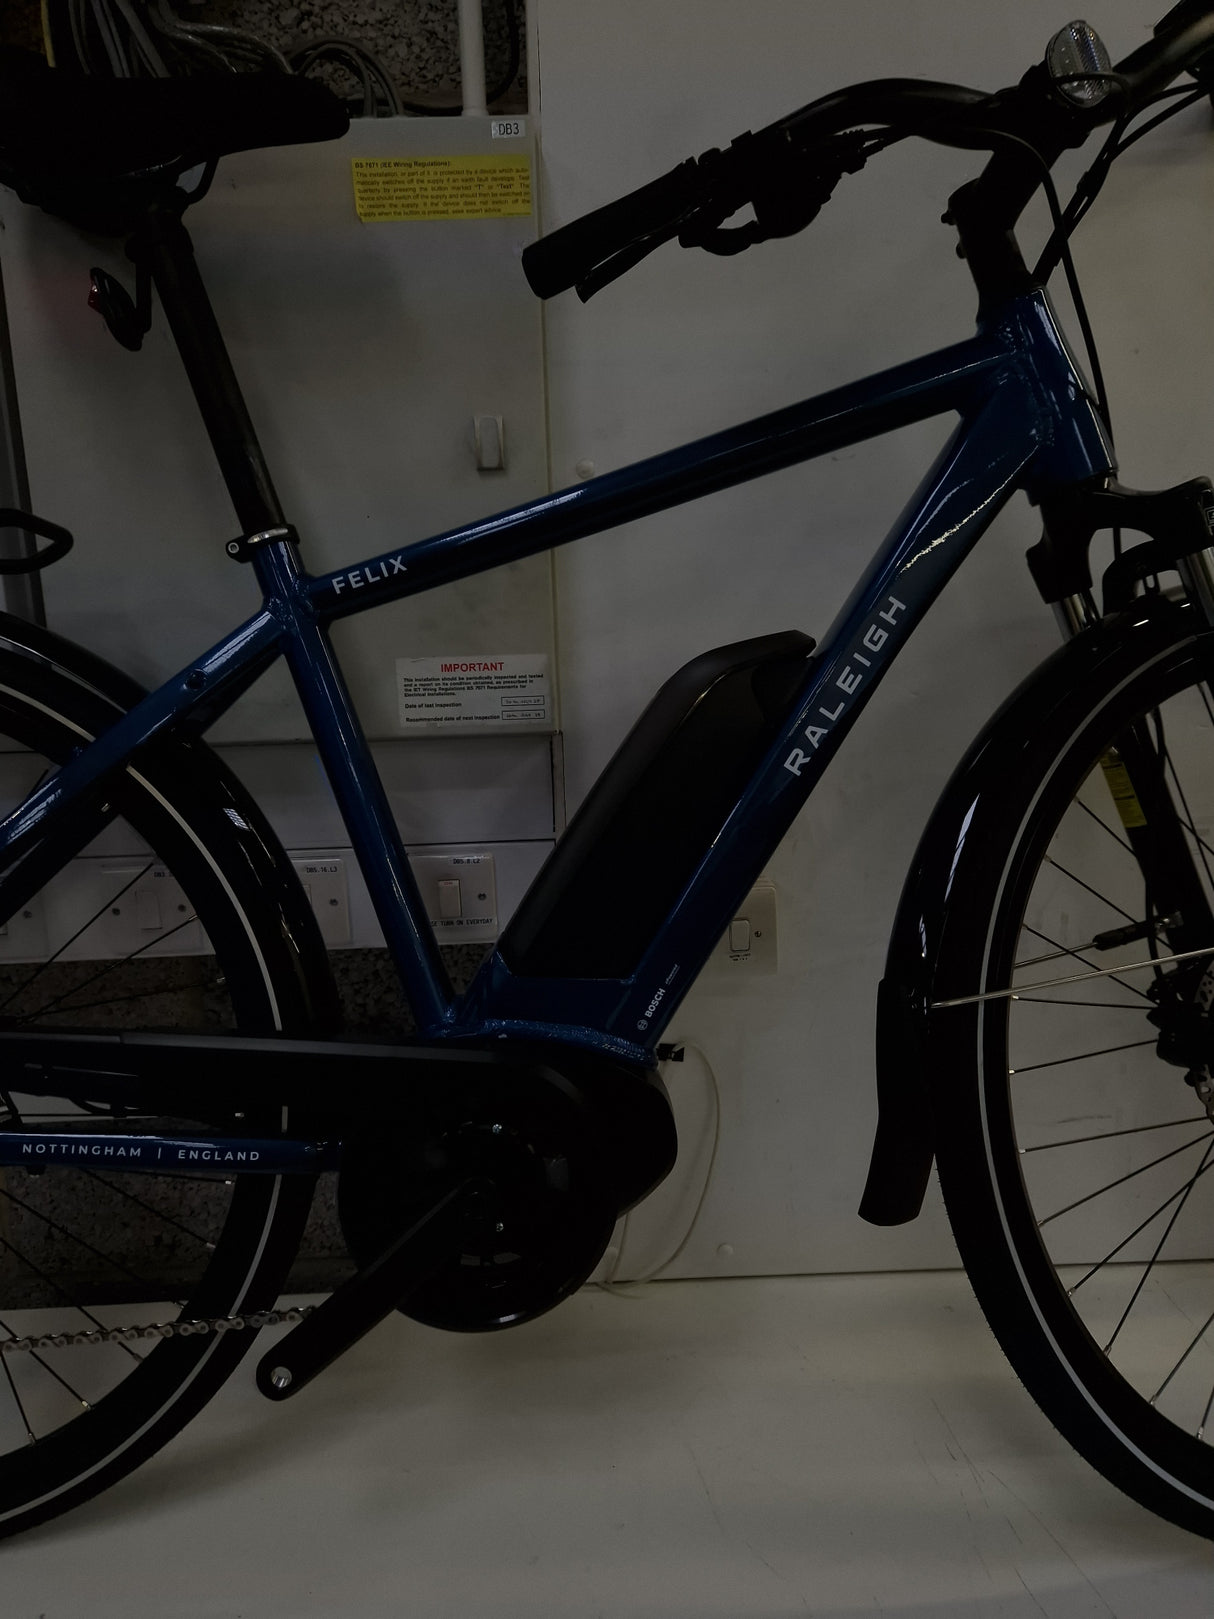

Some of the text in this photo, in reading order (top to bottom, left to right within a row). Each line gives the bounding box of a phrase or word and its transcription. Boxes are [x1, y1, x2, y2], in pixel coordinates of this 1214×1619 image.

[498, 122, 519, 136] DB3
[393, 161, 412, 169] Wiring
[332, 555, 408, 594] FELIX
[440, 662, 504, 673] IMPORTANT
[784, 596, 906, 776] RALEIGH
[644, 988, 666, 1018] BOSCH
[22, 1143, 260, 1161] NOTTINGHAM ENGLAND
